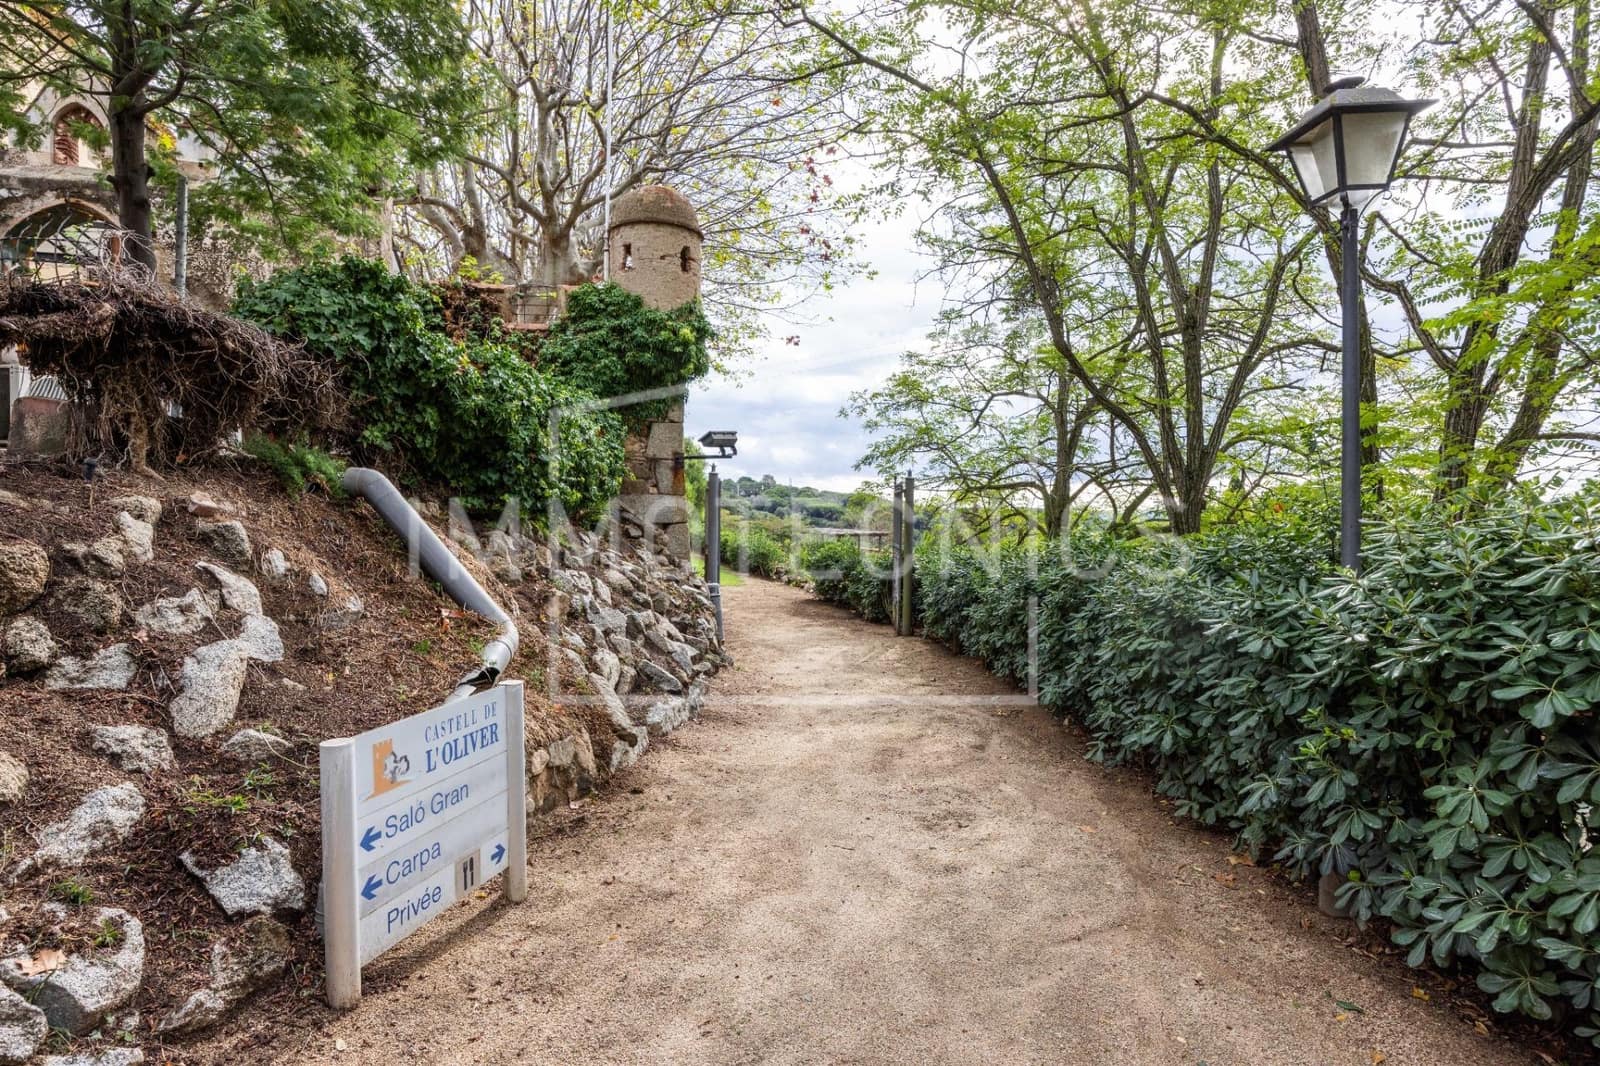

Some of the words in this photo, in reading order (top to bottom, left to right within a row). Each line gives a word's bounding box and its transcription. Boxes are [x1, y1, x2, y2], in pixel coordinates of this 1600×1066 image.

[424, 709, 478, 744] CASTELL
[484, 701, 497, 720] DE
[425, 722, 500, 774] L'OLIVER
[385, 800, 425, 839] Saló
[430, 783, 469, 815] Gran
[385, 841, 442, 885] Carpa
[386, 885, 442, 934] Privée
